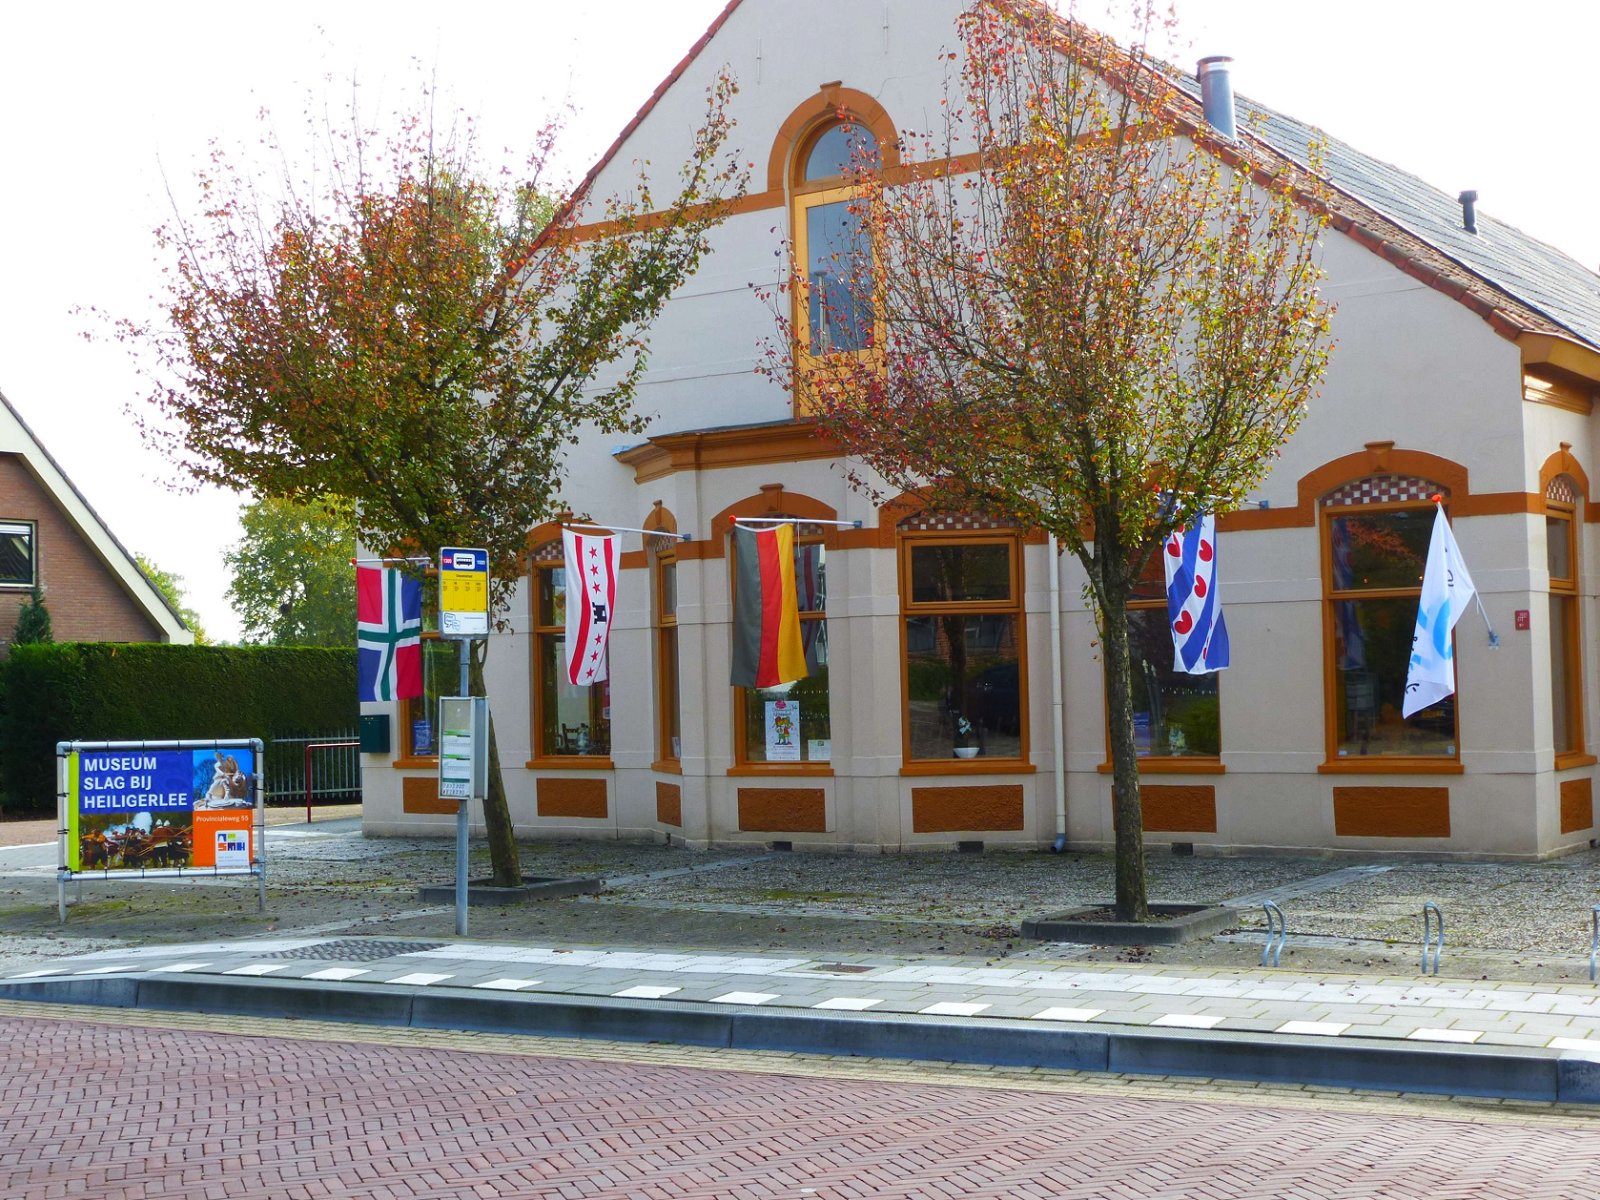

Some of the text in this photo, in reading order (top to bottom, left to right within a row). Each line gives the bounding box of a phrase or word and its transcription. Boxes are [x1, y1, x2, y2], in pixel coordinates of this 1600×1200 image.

[84, 757, 157, 772] MUSEUM
[83, 775, 152, 791] SLAG BIJ
[84, 793, 188, 809] HEILIGERLEE
[195, 814, 240, 824] Provincialeweg
